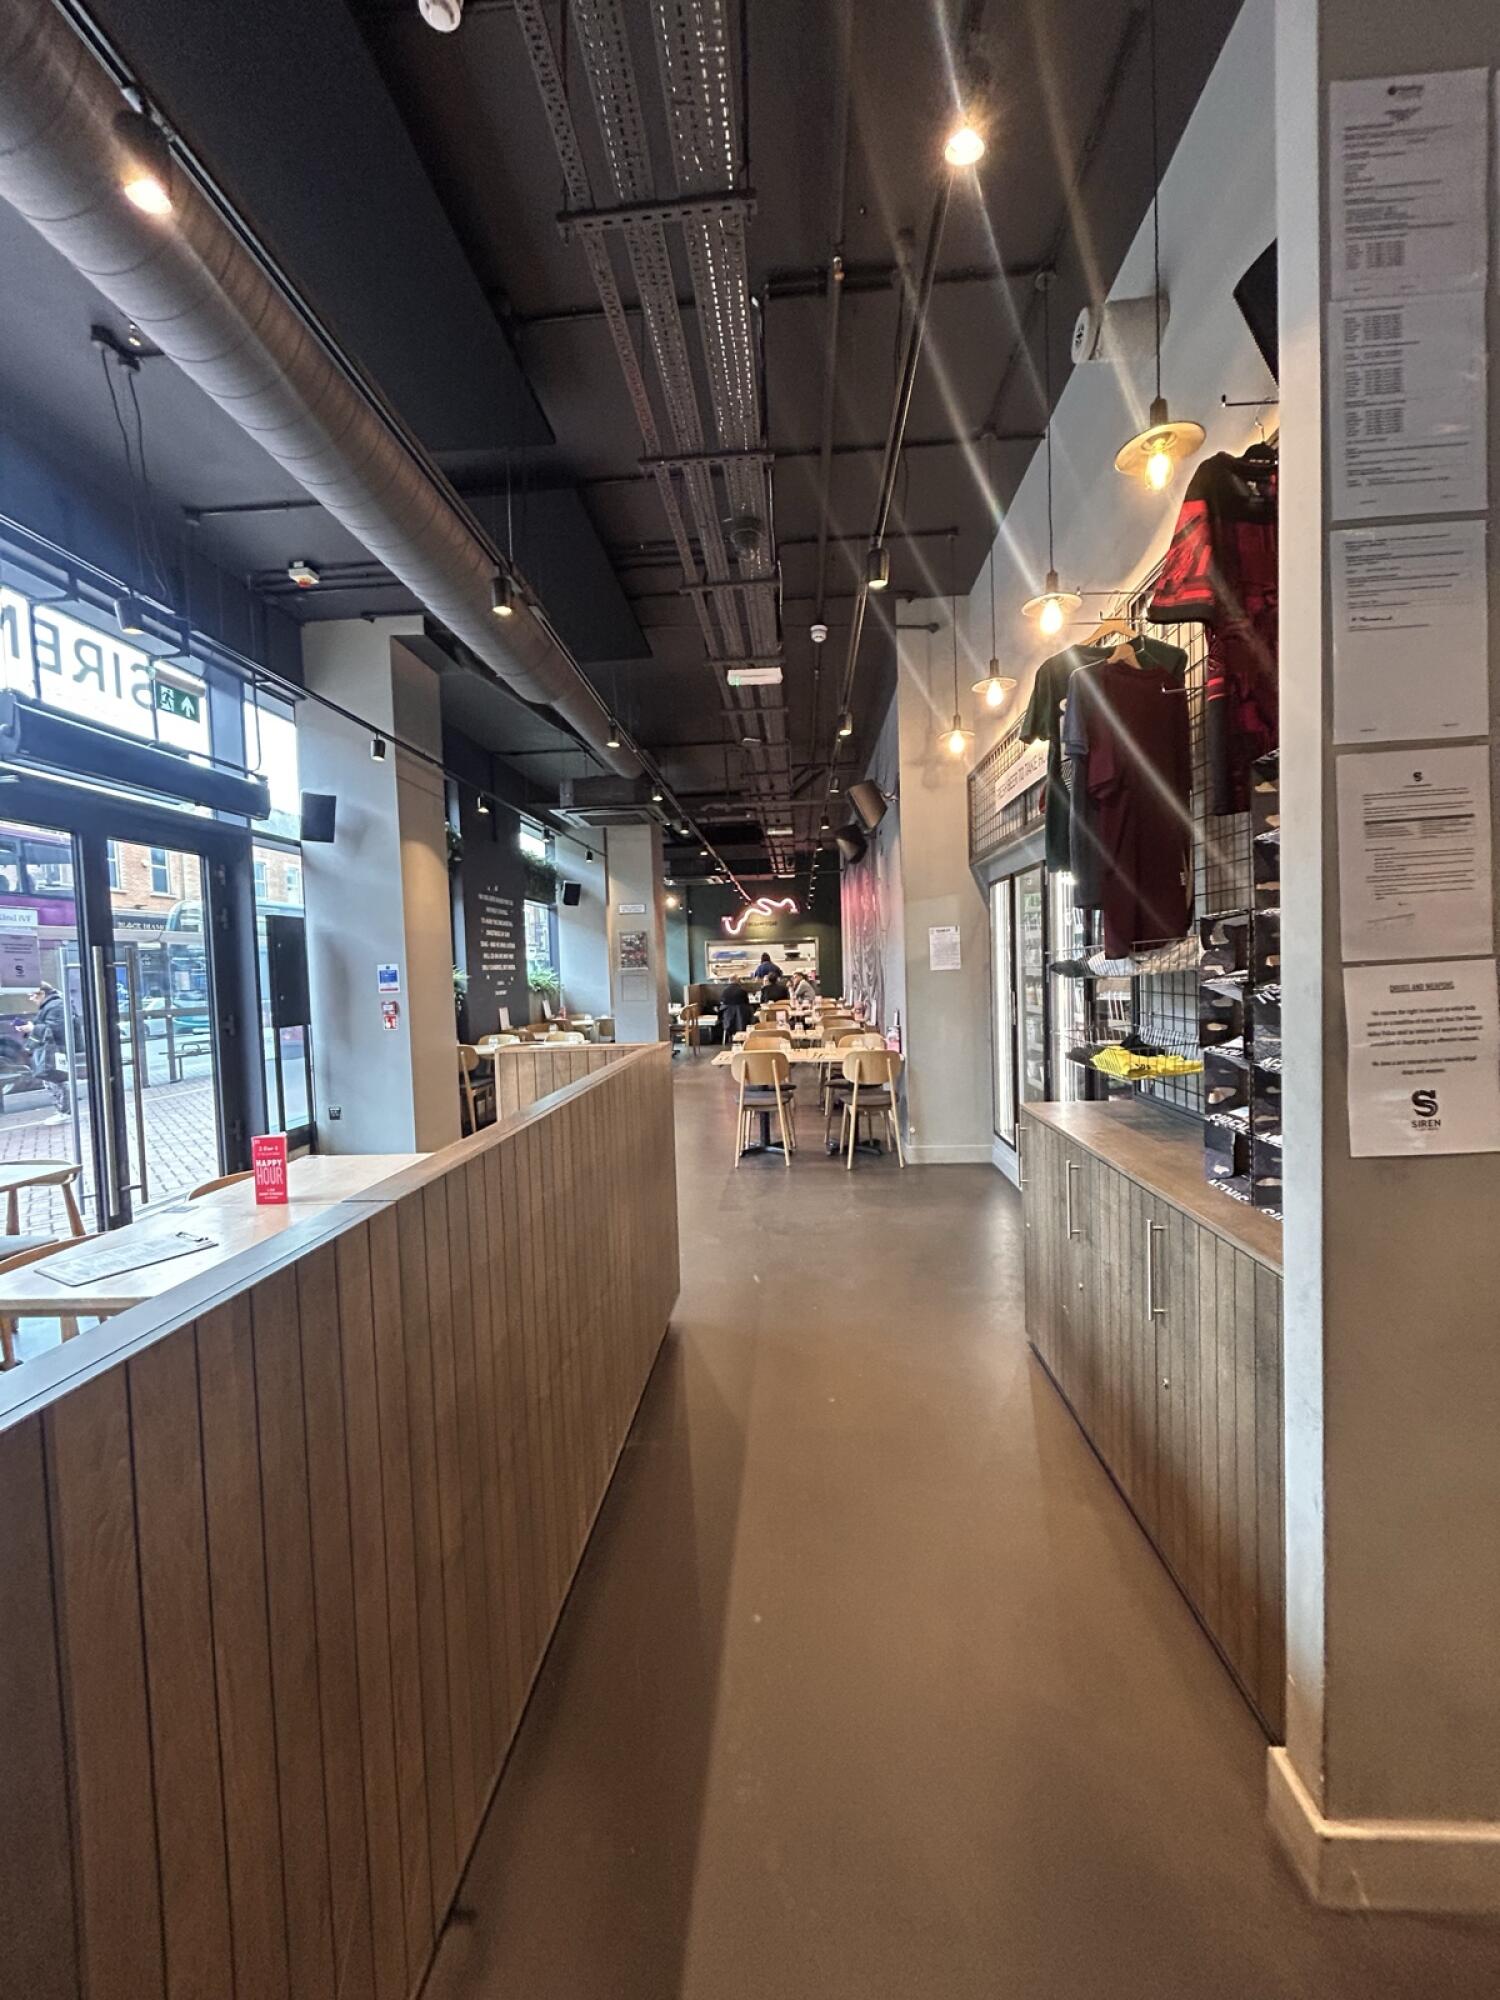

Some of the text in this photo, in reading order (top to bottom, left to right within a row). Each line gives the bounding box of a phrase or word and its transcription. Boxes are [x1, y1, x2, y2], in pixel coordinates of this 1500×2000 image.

[1411, 1090, 1439, 1117] S
[1411, 1119, 1441, 1129] SIREN
[256, 1159, 282, 1167] HAPPY
[256, 1167, 283, 1185] HOUR
